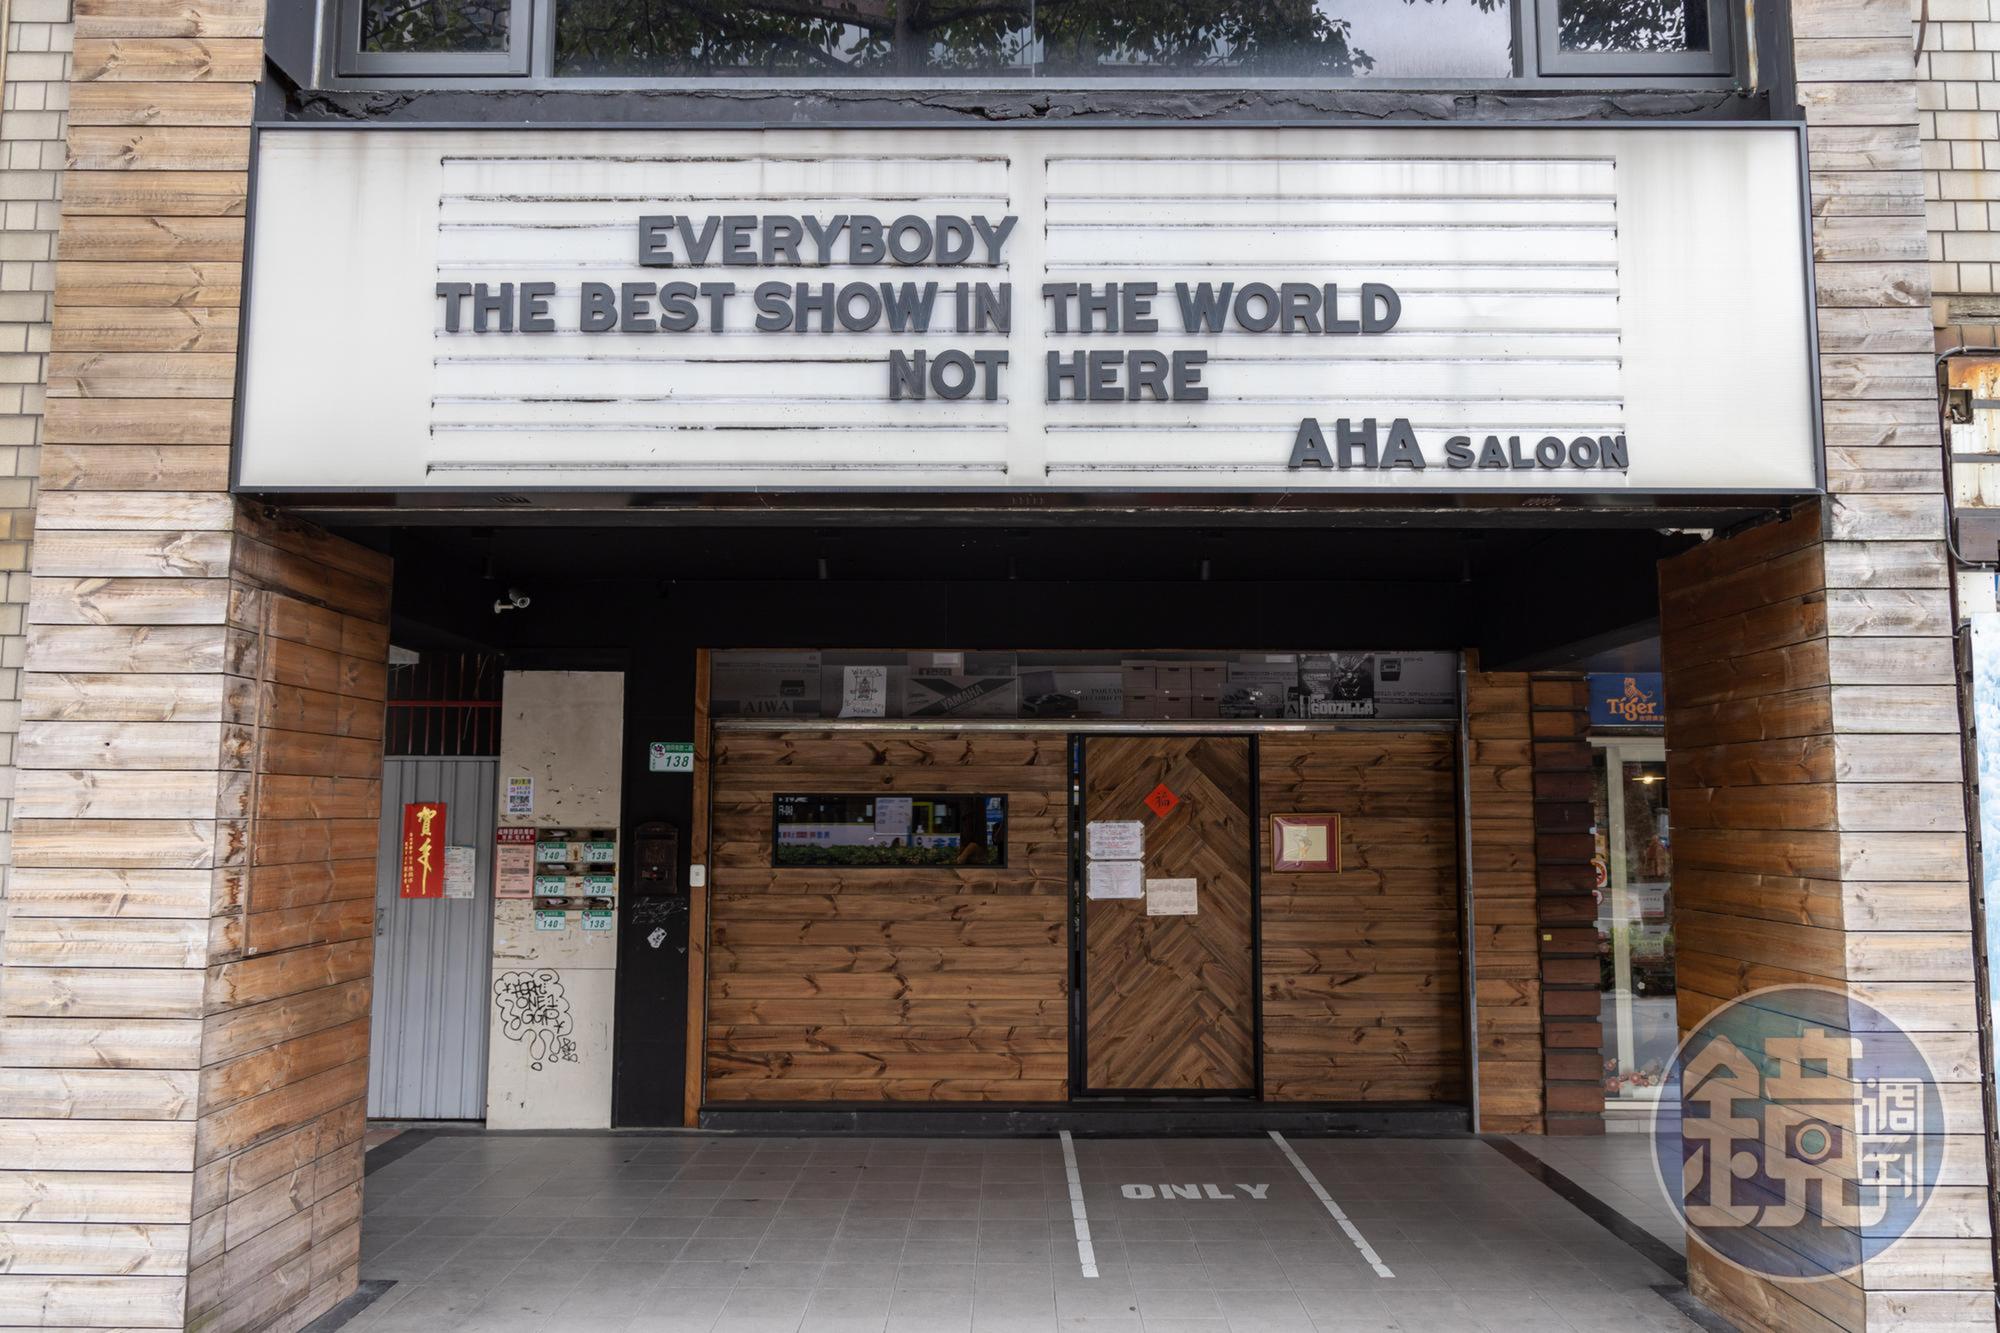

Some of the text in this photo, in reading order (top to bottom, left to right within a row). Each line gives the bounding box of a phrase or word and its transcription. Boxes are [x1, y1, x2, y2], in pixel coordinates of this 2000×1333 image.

[639, 215, 1018, 269] EVERYBODY
[436, 281, 1402, 334] THE BEST SHOW IN THE WORLD
[889, 349, 1209, 403] NOT HERE
[1288, 417, 1630, 472] AHA SALOON
[942, 684, 984, 711] YAMAHA
[744, 699, 790, 713] AIWA
[1311, 700, 1374, 715] GODZILLA
[1606, 696, 1657, 721] Tiger
[666, 755, 689, 768] 138
[544, 852, 560, 860] 140
[591, 852, 607, 860] 138
[543, 885, 559, 893] 140
[591, 885, 607, 893] 138
[543, 920, 558, 928] 140
[590, 920, 605, 928] 138
[1120, 1183, 1271, 1200] ONLY
